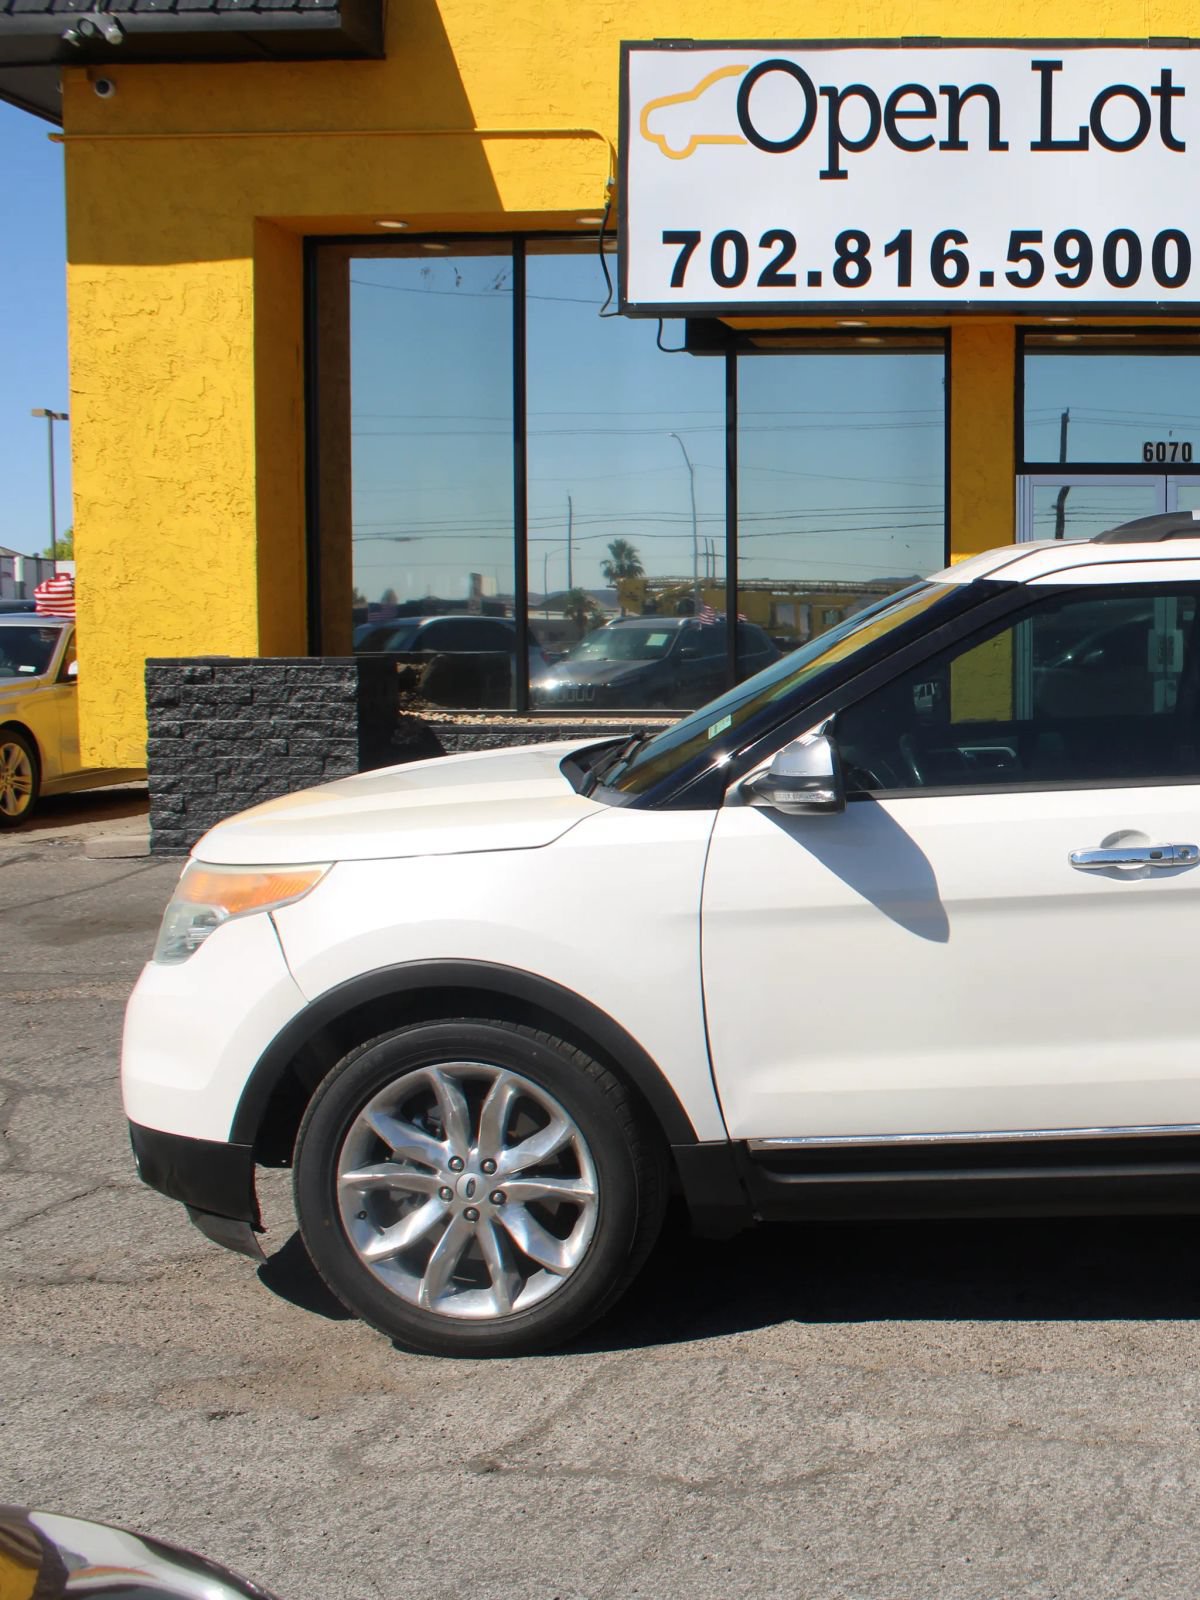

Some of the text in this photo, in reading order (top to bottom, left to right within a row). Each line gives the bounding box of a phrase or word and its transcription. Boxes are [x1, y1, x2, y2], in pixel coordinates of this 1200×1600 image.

[736, 58, 1010, 180] Open
[1030, 59, 1187, 153] Lot
[662, 228, 1192, 289] 702.816.5900
[1143, 441, 1193, 463] 6070
